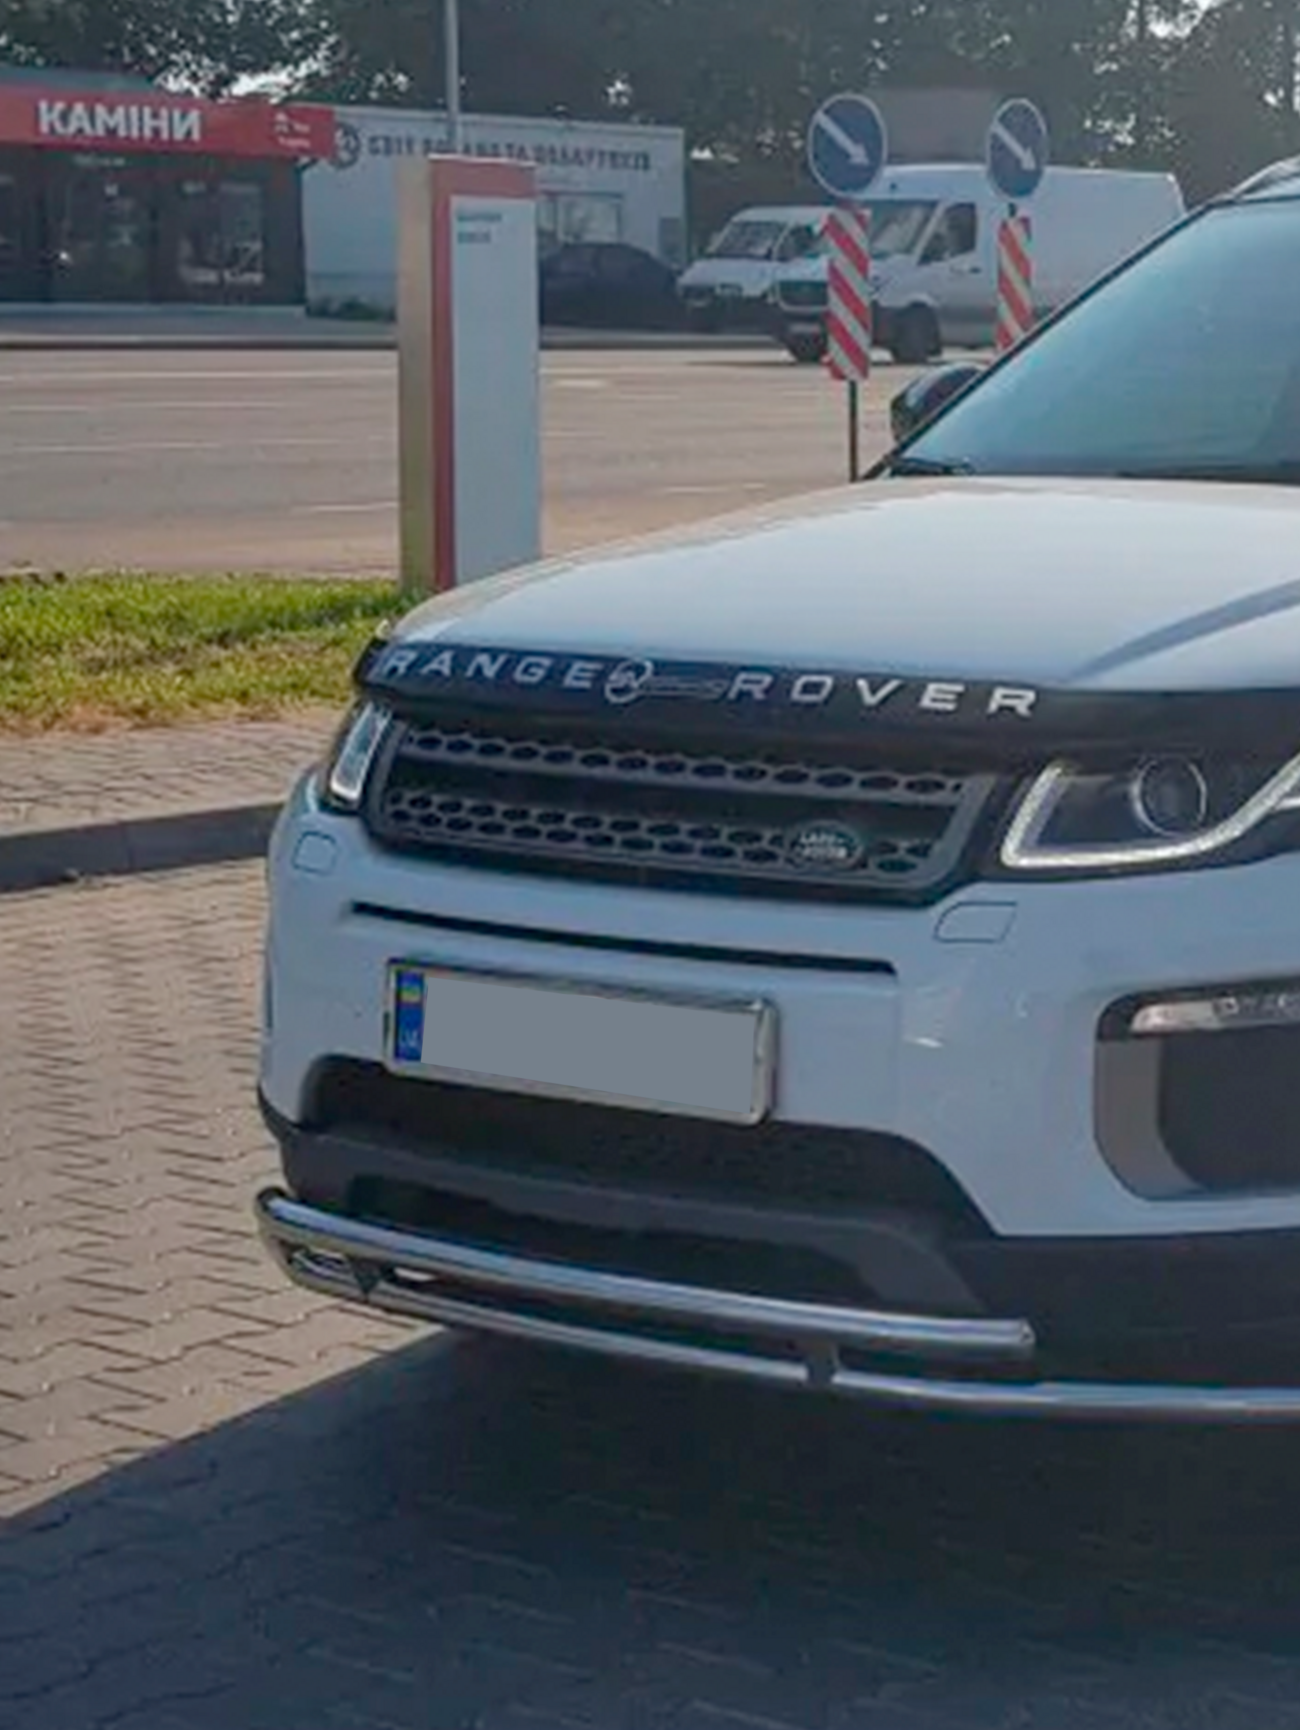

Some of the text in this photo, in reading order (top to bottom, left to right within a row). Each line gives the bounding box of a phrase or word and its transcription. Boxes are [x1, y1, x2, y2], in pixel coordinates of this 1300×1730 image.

[38, 100, 202, 142] КАМІНИ
[383, 650, 1037, 717] RANGE ROVER
